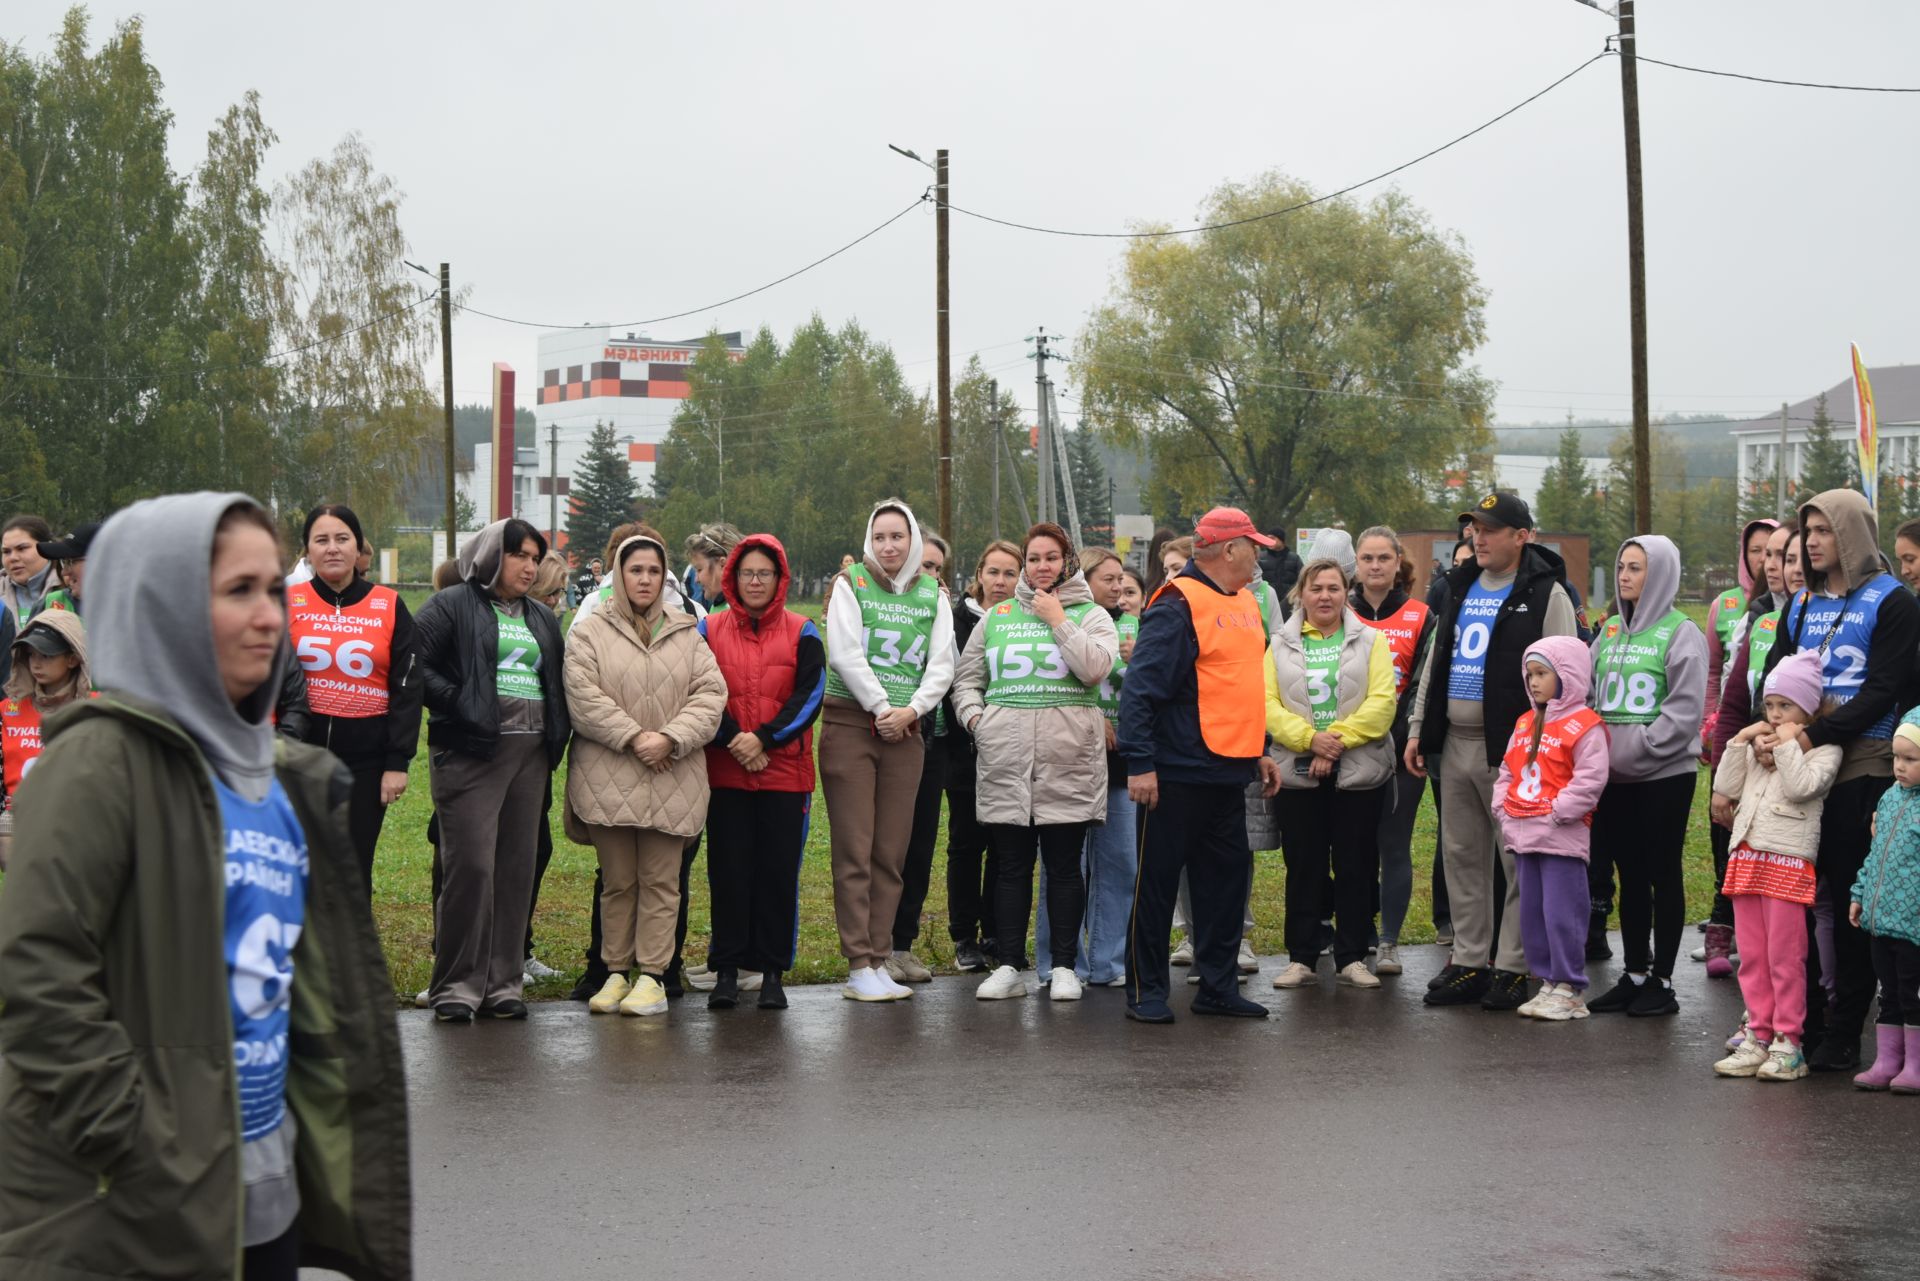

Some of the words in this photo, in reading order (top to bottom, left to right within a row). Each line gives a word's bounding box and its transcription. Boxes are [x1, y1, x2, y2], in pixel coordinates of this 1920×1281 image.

[861, 600, 931, 617] ТУКАЕВСКИЙ
[878, 612, 914, 625] РАЙОН
[313, 621, 364, 635] РАЙОН
[1006, 629, 1049, 640] РАЙОН
[1807, 624, 1844, 636] РАЙН
[862, 626, 928, 672] 134
[296, 636, 375, 678] 56
[986, 643, 1071, 682] 153
[310, 678, 356, 693] НОРМА
[1002, 683, 1045, 694] НОРМА
[1516, 761, 1542, 801] 8
